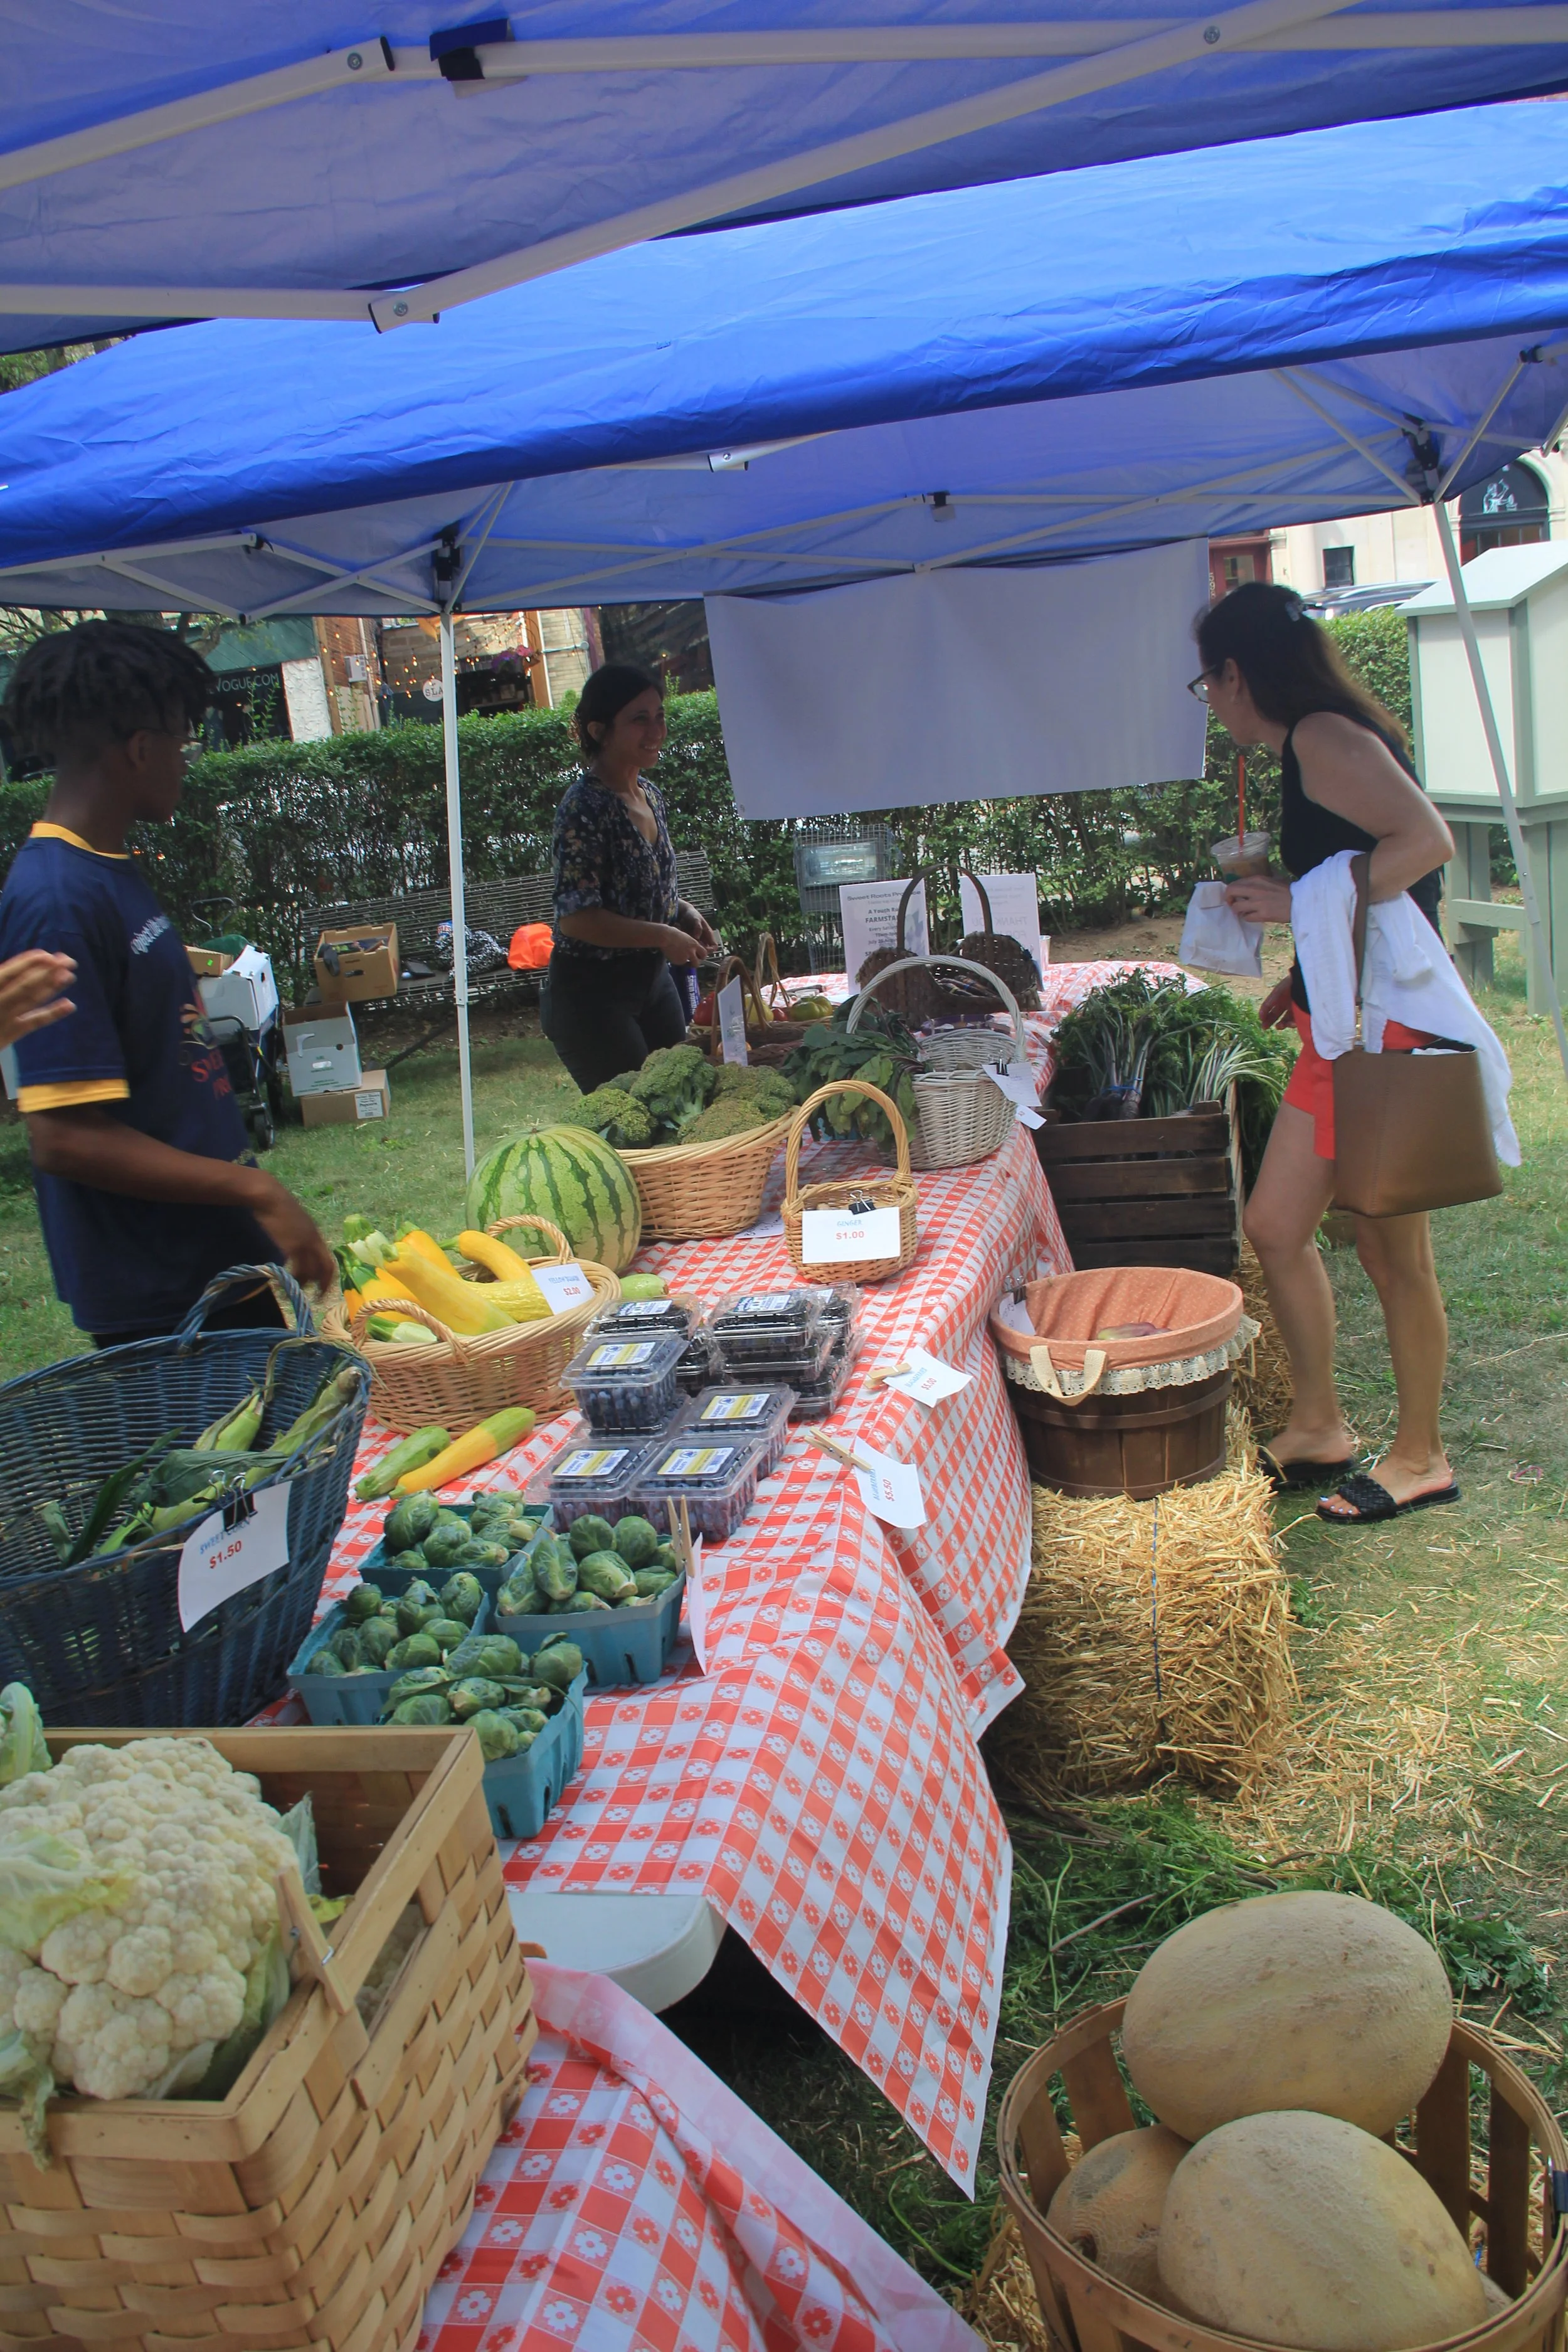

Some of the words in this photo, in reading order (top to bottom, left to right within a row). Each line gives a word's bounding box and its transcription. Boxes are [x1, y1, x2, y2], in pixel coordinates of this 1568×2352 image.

[835, 1231, 865, 1240] $1.00
[920, 1377, 938, 1391] $5.00
[882, 1479, 895, 1502] $5.50
[200, 1531, 224, 1554] SWEET
[209, 1540, 242, 1569] $1.50
